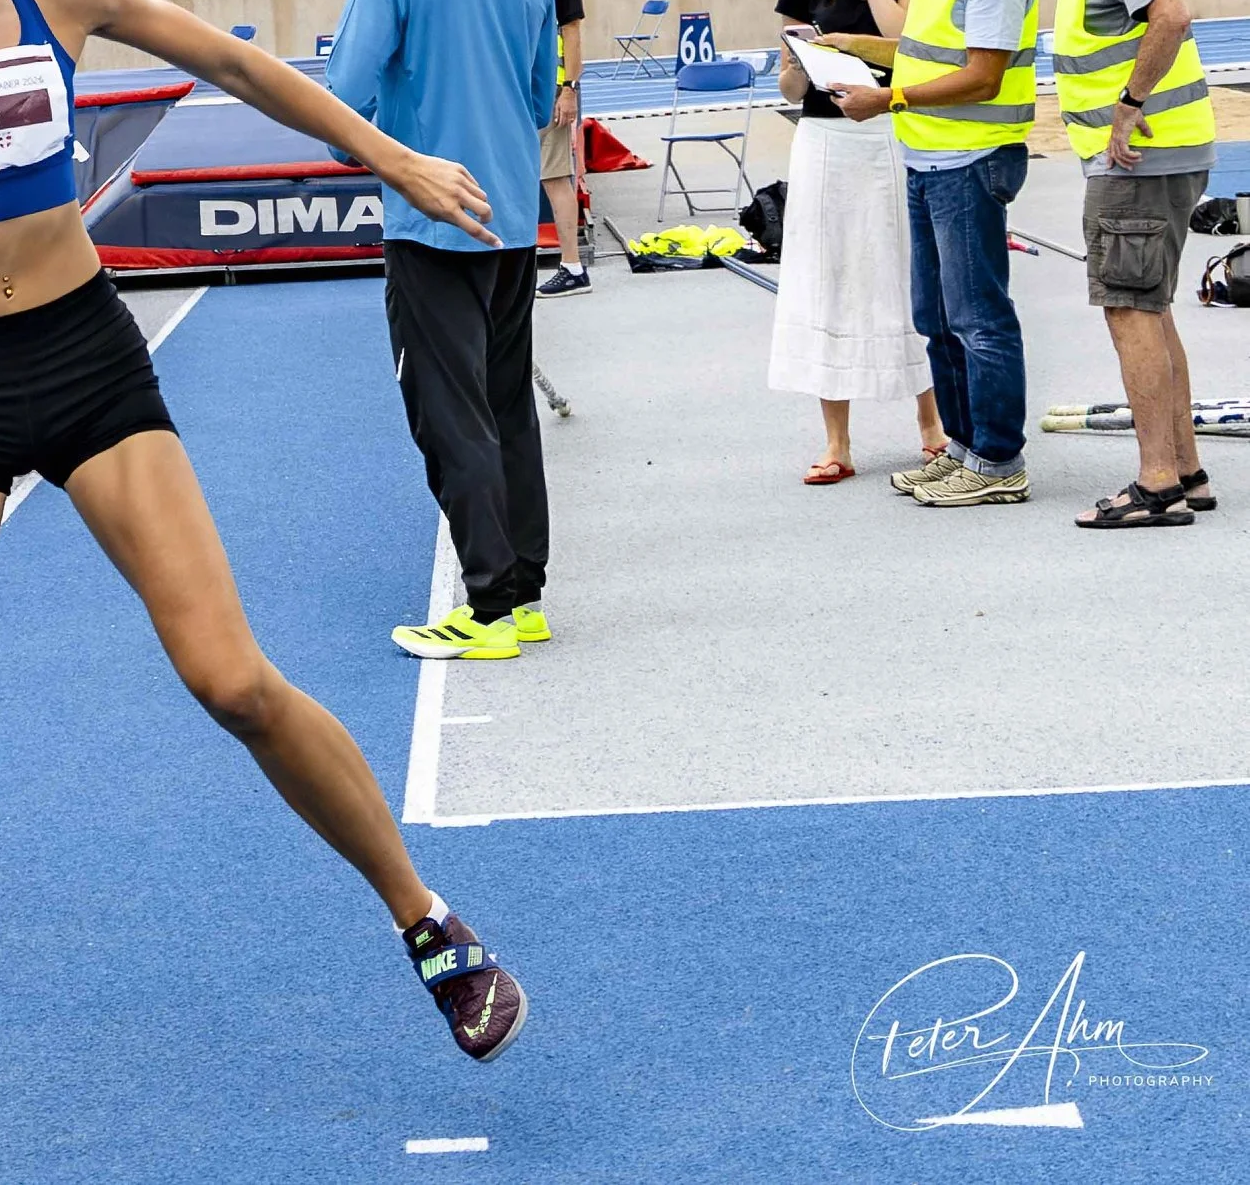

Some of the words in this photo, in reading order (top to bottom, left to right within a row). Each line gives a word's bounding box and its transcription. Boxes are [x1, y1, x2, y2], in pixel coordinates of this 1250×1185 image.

[680, 25, 713, 65] 66
[199, 195, 384, 236] DIMA
[421, 948, 458, 982] NIKE
